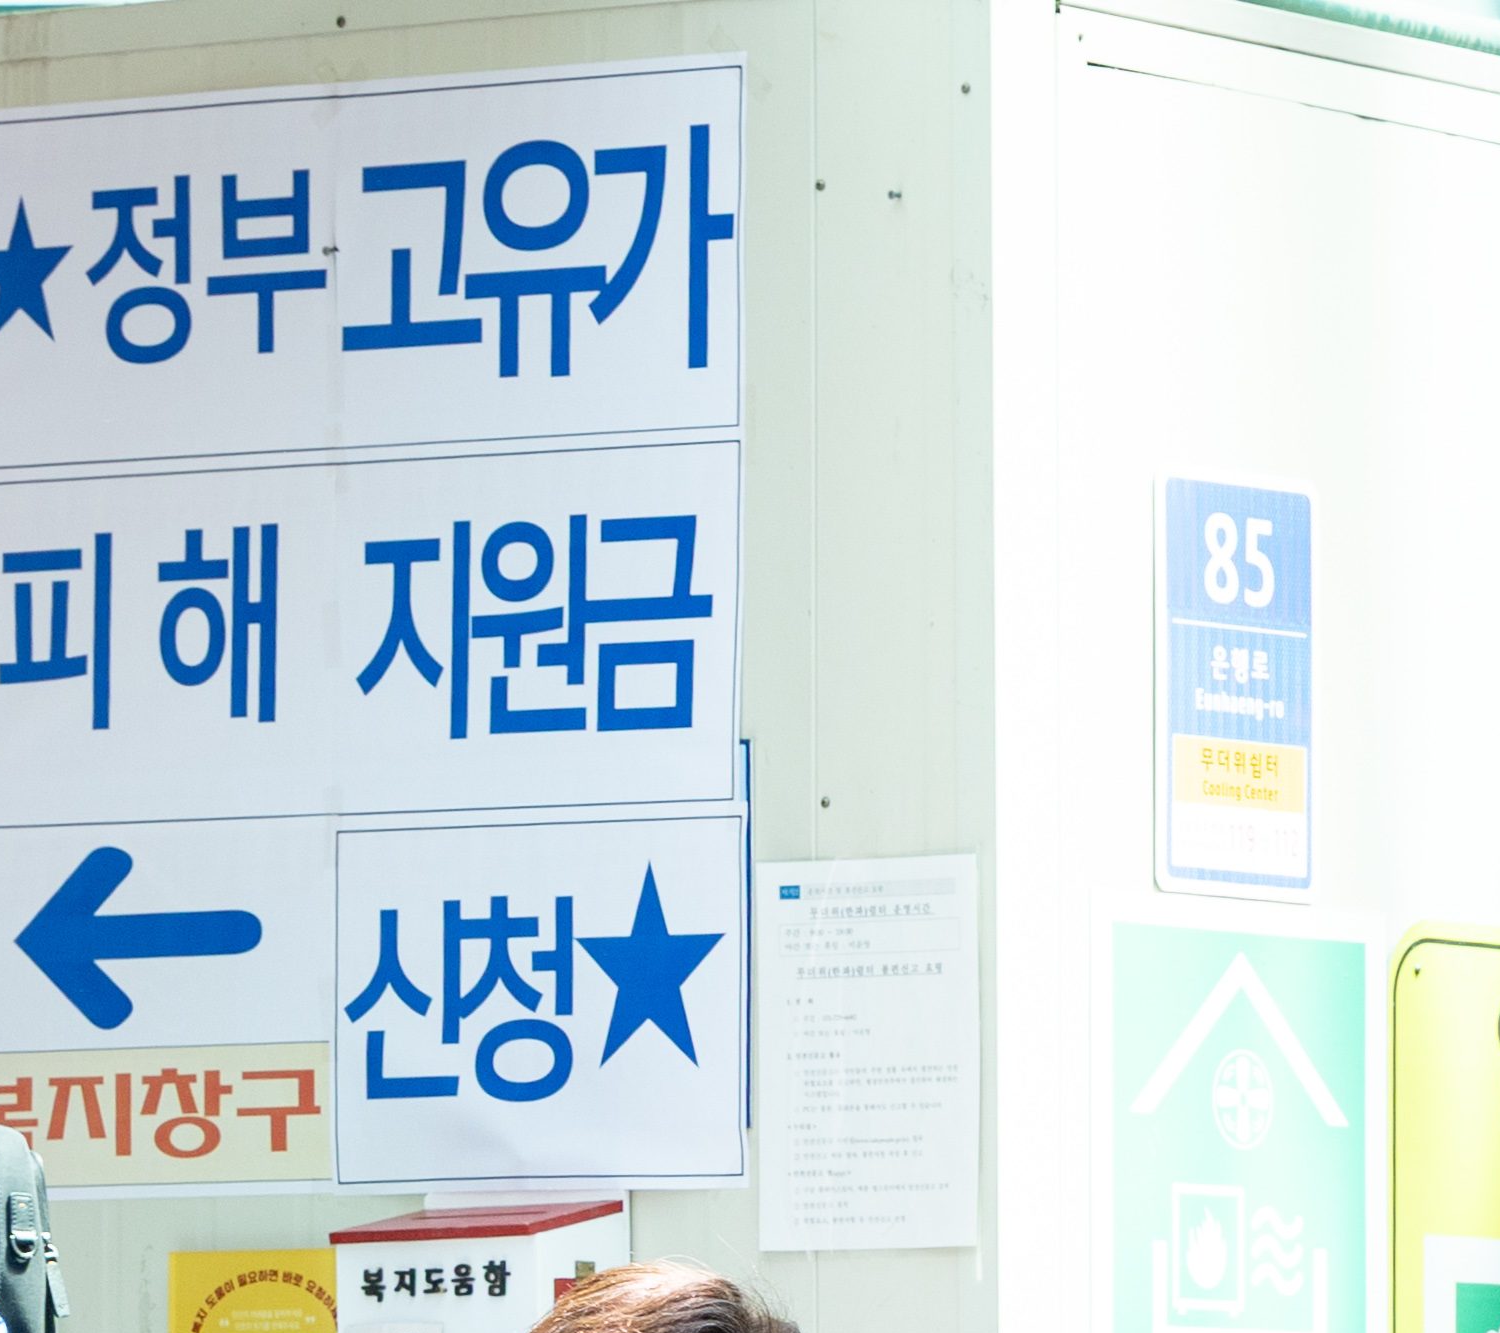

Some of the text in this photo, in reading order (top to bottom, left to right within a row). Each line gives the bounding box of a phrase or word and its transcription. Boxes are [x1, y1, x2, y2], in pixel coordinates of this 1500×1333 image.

[86, 123, 734, 378] 정부 고유가
[1203, 510, 1276, 609] 85
[356, 513, 713, 740] 지원금
[1210, 645, 1270, 684] 은행로
[1195, 687, 1285, 722] Eunhaeng-ro
[1201, 747, 1279, 779] 무더위쉼터
[1202, 780, 1279, 802] Cooling Center
[343, 895, 575, 1102] 신청
[282, 1271, 304, 1287] 바로
[361, 1260, 511, 1302] 복지도움함
